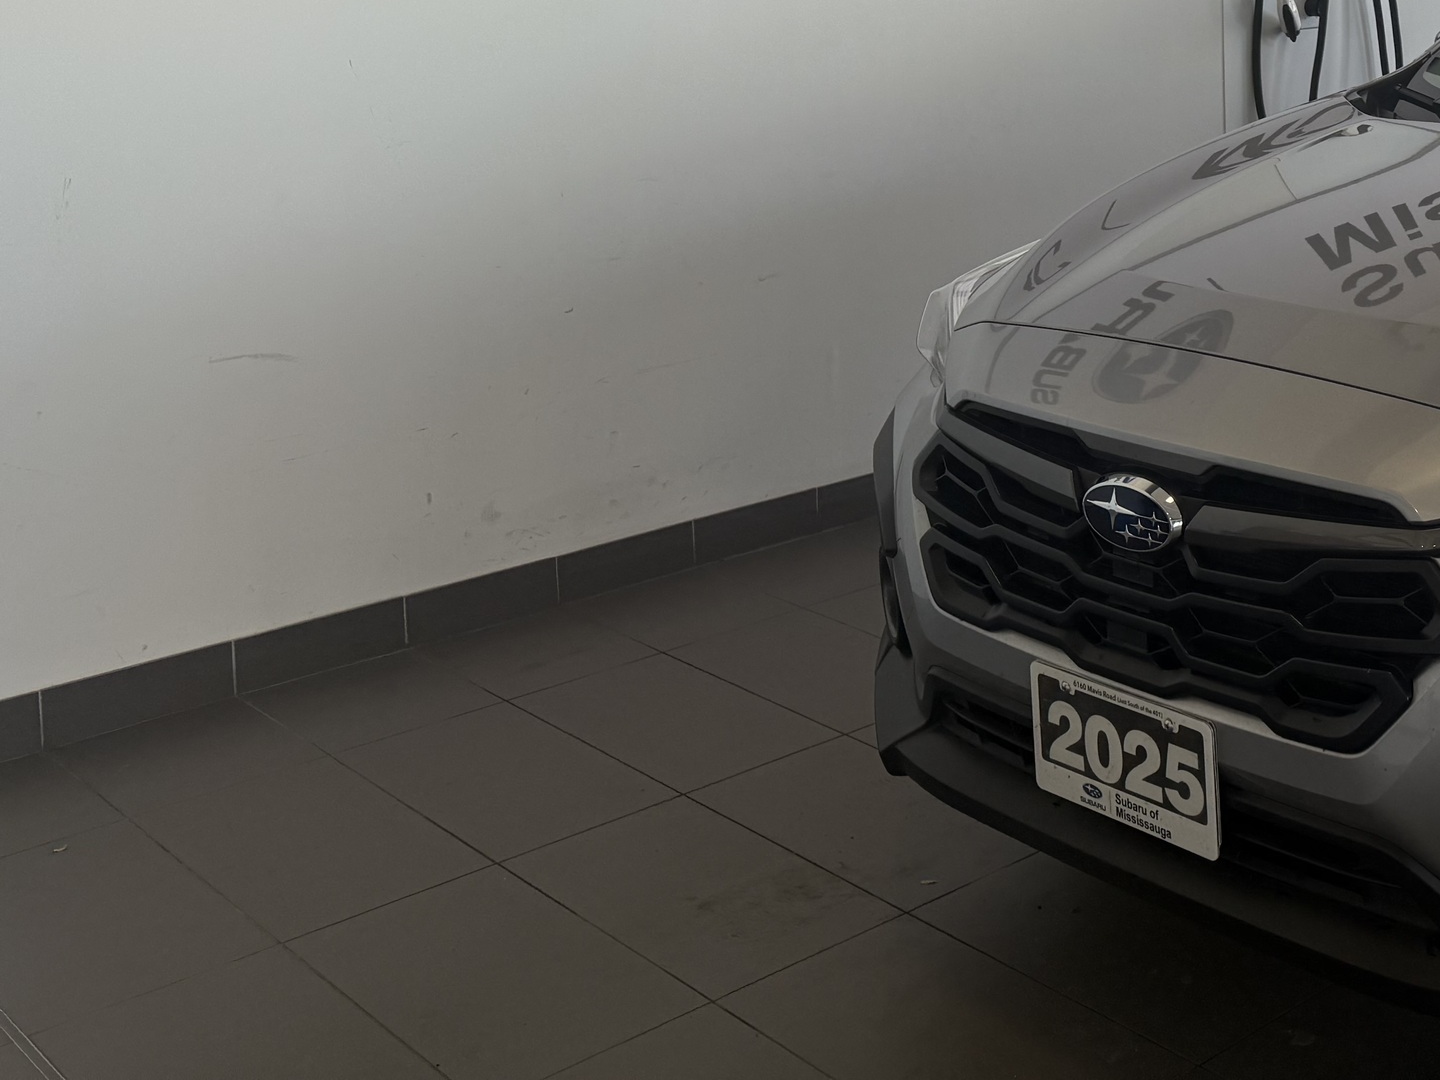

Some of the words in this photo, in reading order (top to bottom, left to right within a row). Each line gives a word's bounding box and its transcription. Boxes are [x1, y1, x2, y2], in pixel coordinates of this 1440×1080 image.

[1073, 680, 1086, 691] 6160
[1087, 685, 1102, 697] Mavis
[1102, 690, 1116, 702] Road
[1127, 700, 1140, 710] South
[1047, 700, 1205, 817] 2025
[1080, 795, 1106, 812] SUBARU
[1115, 793, 1147, 816] Subaru
[1149, 809, 1159, 821] of
[1115, 806, 1172, 839] Mississauga
